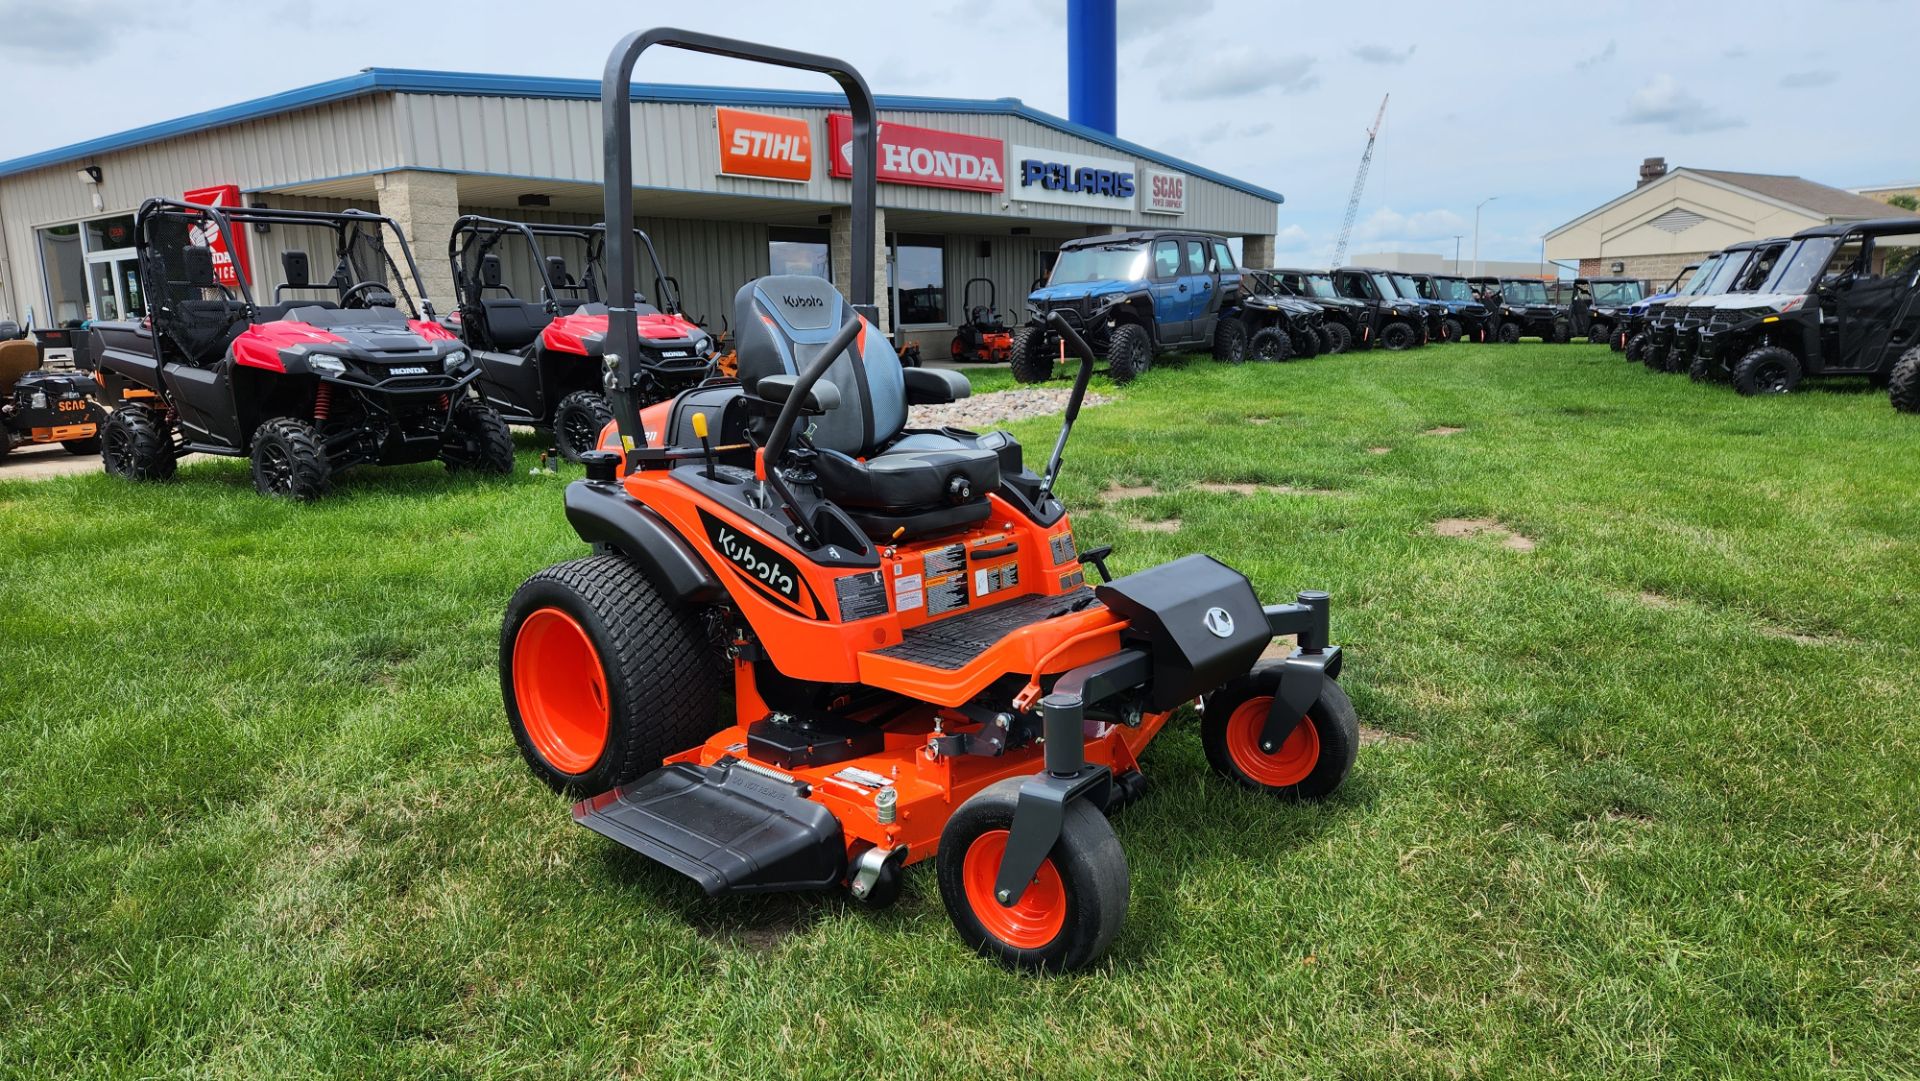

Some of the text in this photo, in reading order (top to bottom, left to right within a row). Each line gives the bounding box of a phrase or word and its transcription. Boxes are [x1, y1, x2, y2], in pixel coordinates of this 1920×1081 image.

[730, 128, 806, 162] STIHL
[882, 143, 1003, 183] HONDA
[1022, 159, 1136, 198] POLARIS
[1152, 175, 1183, 199] SCAG
[211, 251, 232, 264] NDA
[782, 294, 824, 308] Kubota
[389, 366, 428, 375] HONDA
[58, 400, 86, 411] SCAG
[718, 527, 793, 595] Kubota
